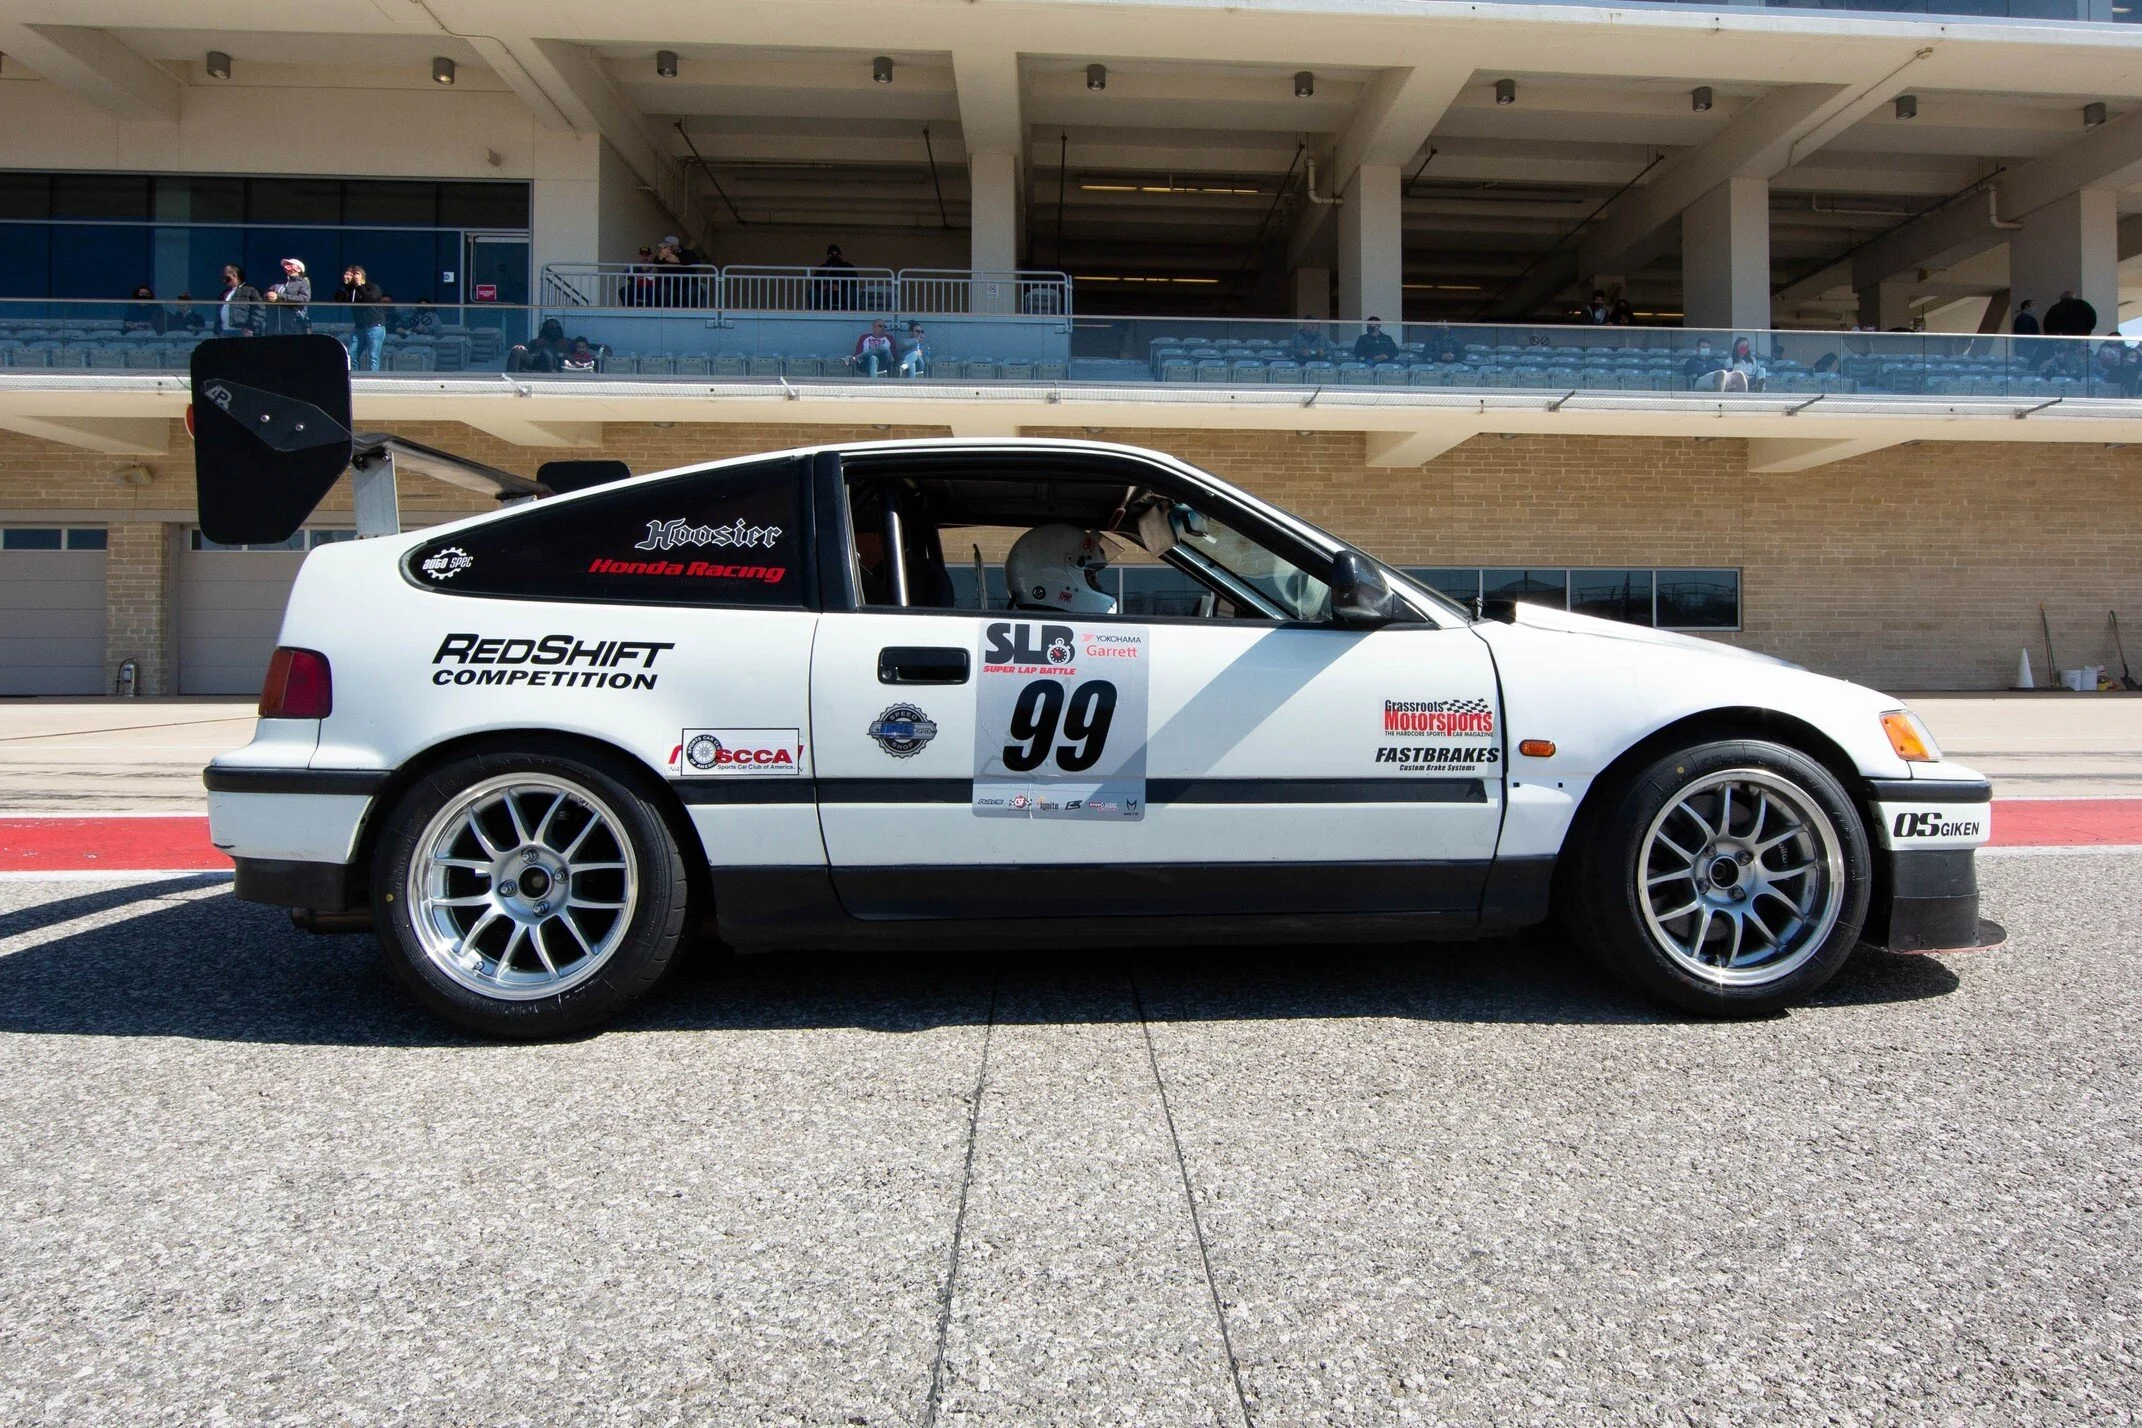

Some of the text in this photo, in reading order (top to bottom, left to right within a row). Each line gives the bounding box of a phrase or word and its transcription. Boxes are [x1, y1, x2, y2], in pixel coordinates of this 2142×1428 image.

[634, 517, 782, 550] Hoosier
[588, 559, 684, 575] Honda
[686, 561, 786, 583] Racing
[985, 622, 1076, 665] SLB
[1096, 635, 1142, 643] YOKOHAMA
[1086, 645, 1137, 658] Garrett
[983, 665, 1077, 675] SUPER LAP BATTLE
[432, 669, 658, 690] COMPETITION
[1384, 699, 1444, 712] Grassroots
[889, 711, 918, 720] SPEED
[1384, 709, 1493, 736] Motorsports
[1002, 679, 1118, 772] 99
[891, 741, 914, 750] SHOP
[715, 749, 793, 764] SCCA
[1375, 747, 1500, 763] FASTBRAKES
[1399, 764, 1425, 772] Custom
[1447, 764, 1476, 772] Systems
[1893, 812, 1979, 837] OS GIKEN
